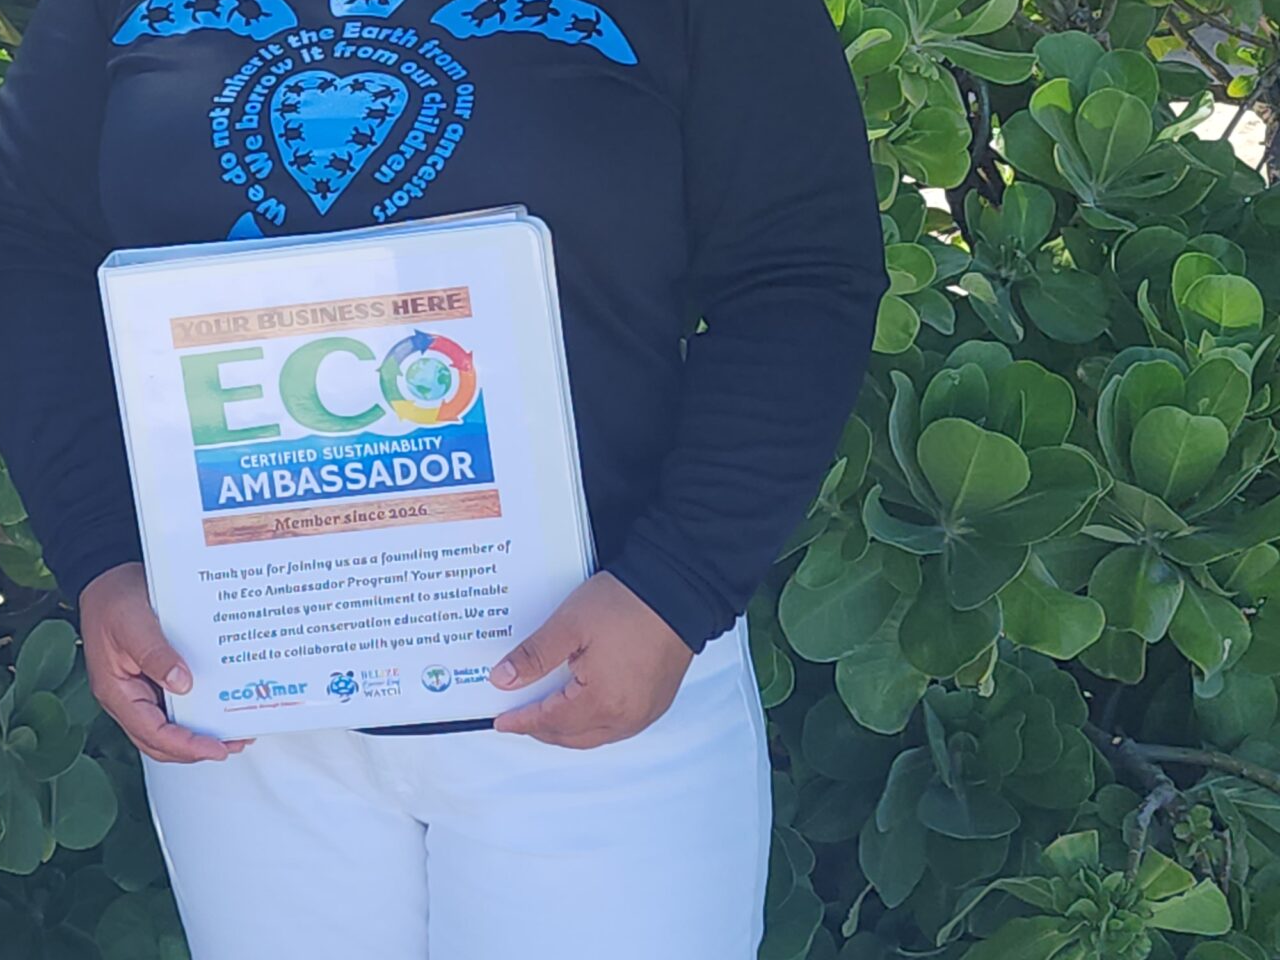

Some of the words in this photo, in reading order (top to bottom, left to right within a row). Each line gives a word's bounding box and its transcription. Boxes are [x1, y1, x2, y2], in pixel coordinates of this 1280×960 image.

[287, 28, 335, 48] the
[333, 41, 399, 66] from
[342, 21, 418, 48] Earth
[400, 61, 438, 88] our
[417, 40, 468, 81] from
[235, 58, 294, 130] borrow
[454, 83, 475, 119] our
[209, 107, 230, 148] not
[374, 92, 447, 184] children
[220, 151, 247, 186] do
[244, 134, 273, 180] We
[372, 122, 465, 223] ancestors
[247, 184, 286, 226] We
[179, 318, 250, 340] YOUR
[256, 301, 385, 331] BUSINESS
[392, 292, 465, 316] HERE
[179, 329, 477, 446] ECO
[217, 451, 476, 505] AMBASSADOR
[240, 448, 317, 469] CERTIFIED
[274, 514, 341, 531] Member
[343, 509, 386, 524] since
[388, 504, 428, 519] 2026
[198, 567, 238, 582] Thank
[240, 565, 263, 580] you
[266, 563, 286, 577] for
[286, 559, 332, 575] joining
[335, 558, 350, 568] us
[352, 556, 368, 566] as
[369, 555, 378, 564] a
[381, 547, 439, 566] founding
[441, 543, 494, 558] member
[497, 539, 511, 554] of
[218, 590, 238, 601] the
[240, 588, 263, 599] Eco
[265, 579, 345, 596] Ambassador
[347, 570, 408, 588] Program!
[411, 569, 442, 581] Your
[444, 564, 497, 579] support
[213, 605, 301, 623] demonstrates
[303, 603, 333, 616] your
[335, 592, 415, 610] commitment
[418, 592, 431, 602] to
[433, 584, 509, 601] sustainable
[218, 627, 277, 646] practices
[279, 624, 304, 637] and
[306, 616, 391, 634] conservation
[394, 611, 463, 626] education.
[464, 607, 484, 618] We
[487, 606, 510, 617] are
[220, 649, 267, 664] excited
[269, 648, 282, 660] to
[284, 640, 357, 657] collaborate
[359, 637, 388, 651] with
[390, 636, 414, 650] you
[416, 632, 441, 644] and
[443, 630, 473, 644] your
[475, 624, 513, 638] team!
